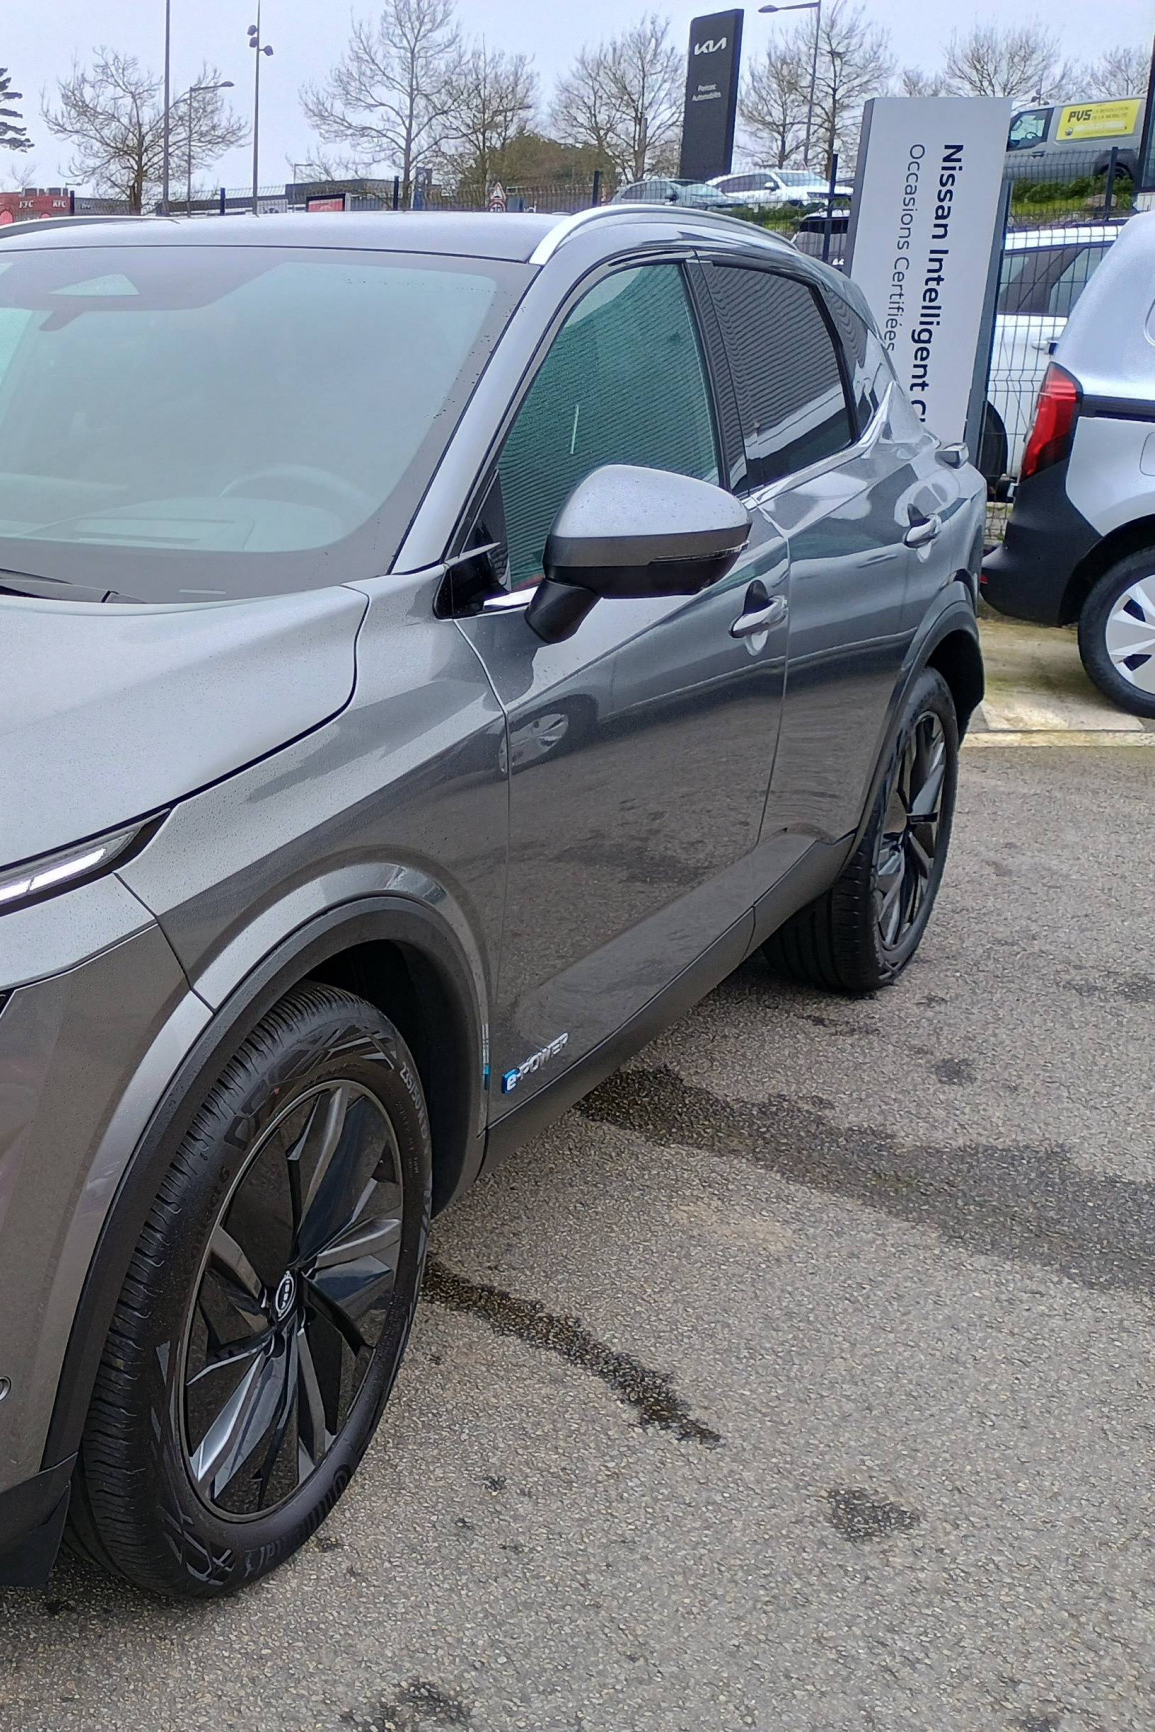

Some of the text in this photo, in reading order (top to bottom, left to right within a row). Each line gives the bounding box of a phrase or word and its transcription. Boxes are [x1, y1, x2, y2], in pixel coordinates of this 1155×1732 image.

[884, 144, 926, 352] Occasions Certifiées
[931, 144, 964, 240] Nissan
[910, 249, 950, 392] Intelligent
